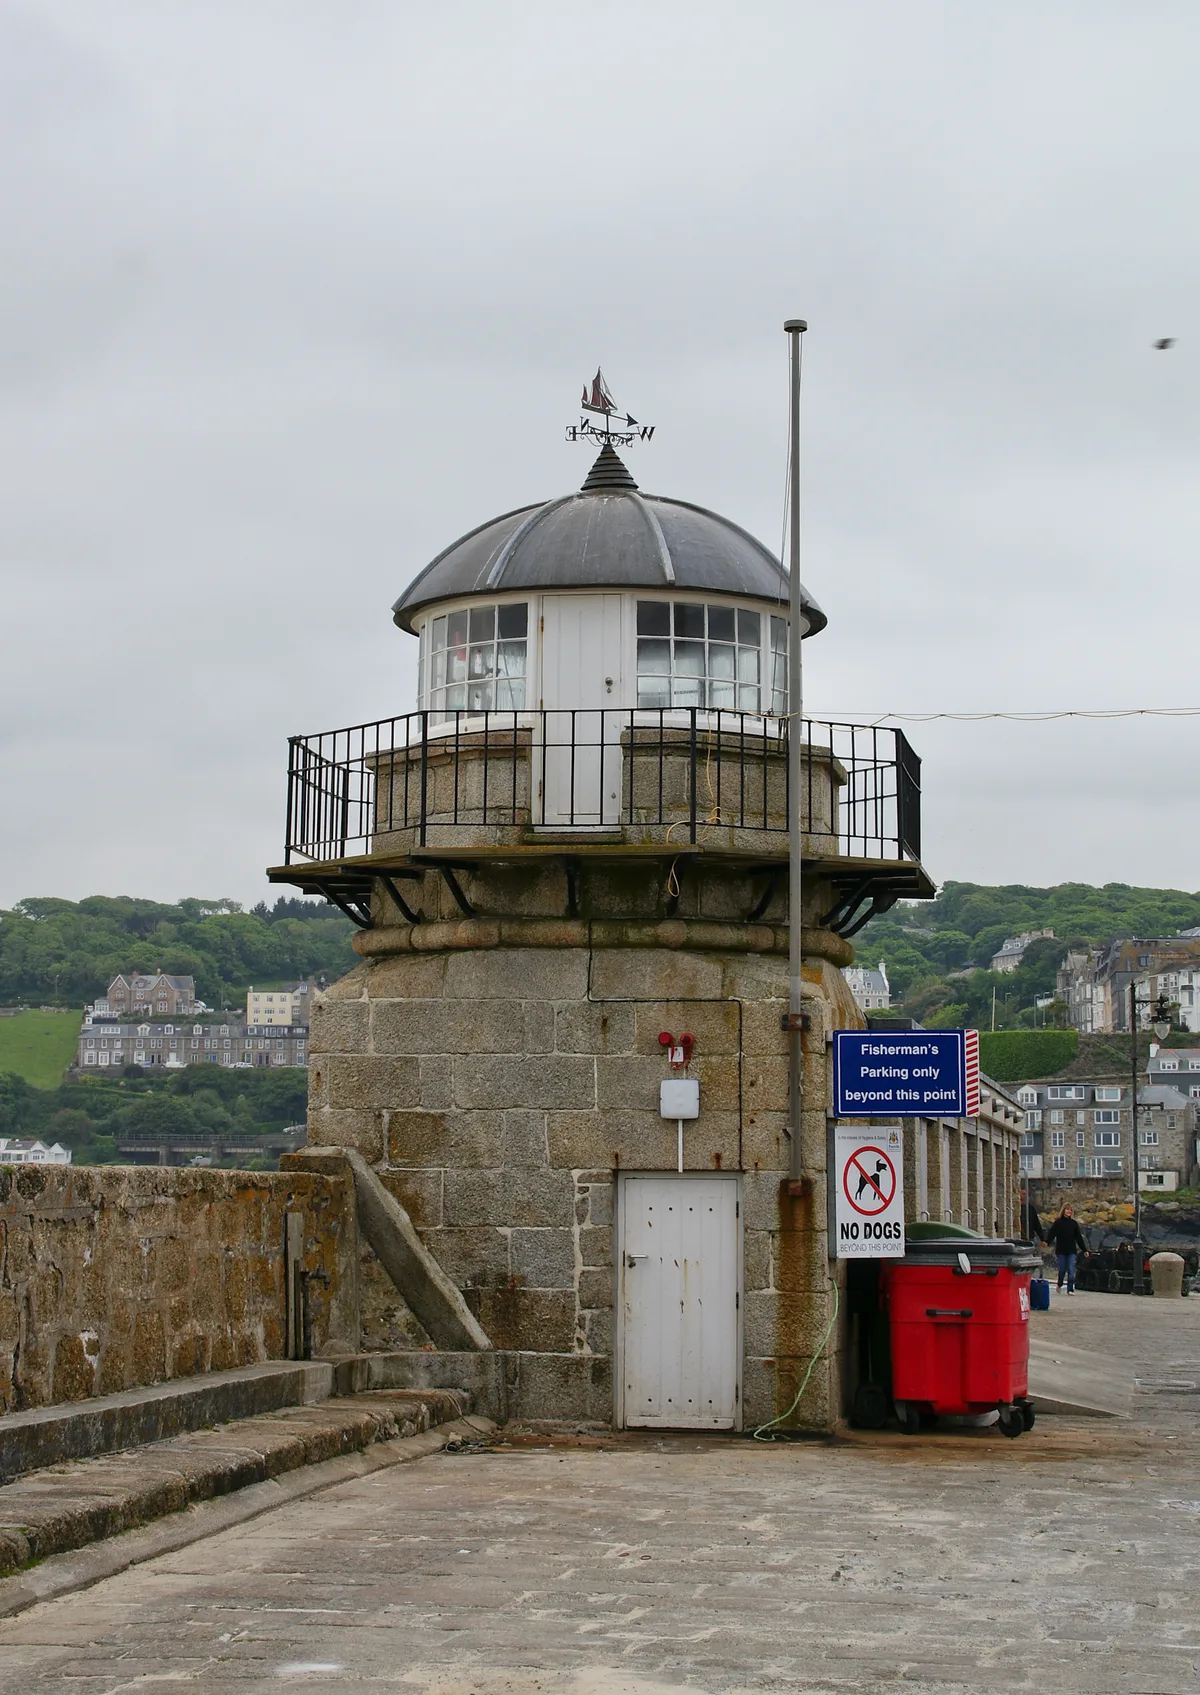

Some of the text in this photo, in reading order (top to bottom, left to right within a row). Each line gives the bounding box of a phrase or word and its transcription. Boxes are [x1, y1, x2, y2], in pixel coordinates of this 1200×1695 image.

[861, 1043, 939, 1056] Fisherman's
[860, 1066, 940, 1080] Parking only
[845, 1089, 957, 1103] beyond this point
[840, 1221, 902, 1240] NO DOGS
[840, 1243, 902, 1252] BEYOND THIS POINT
